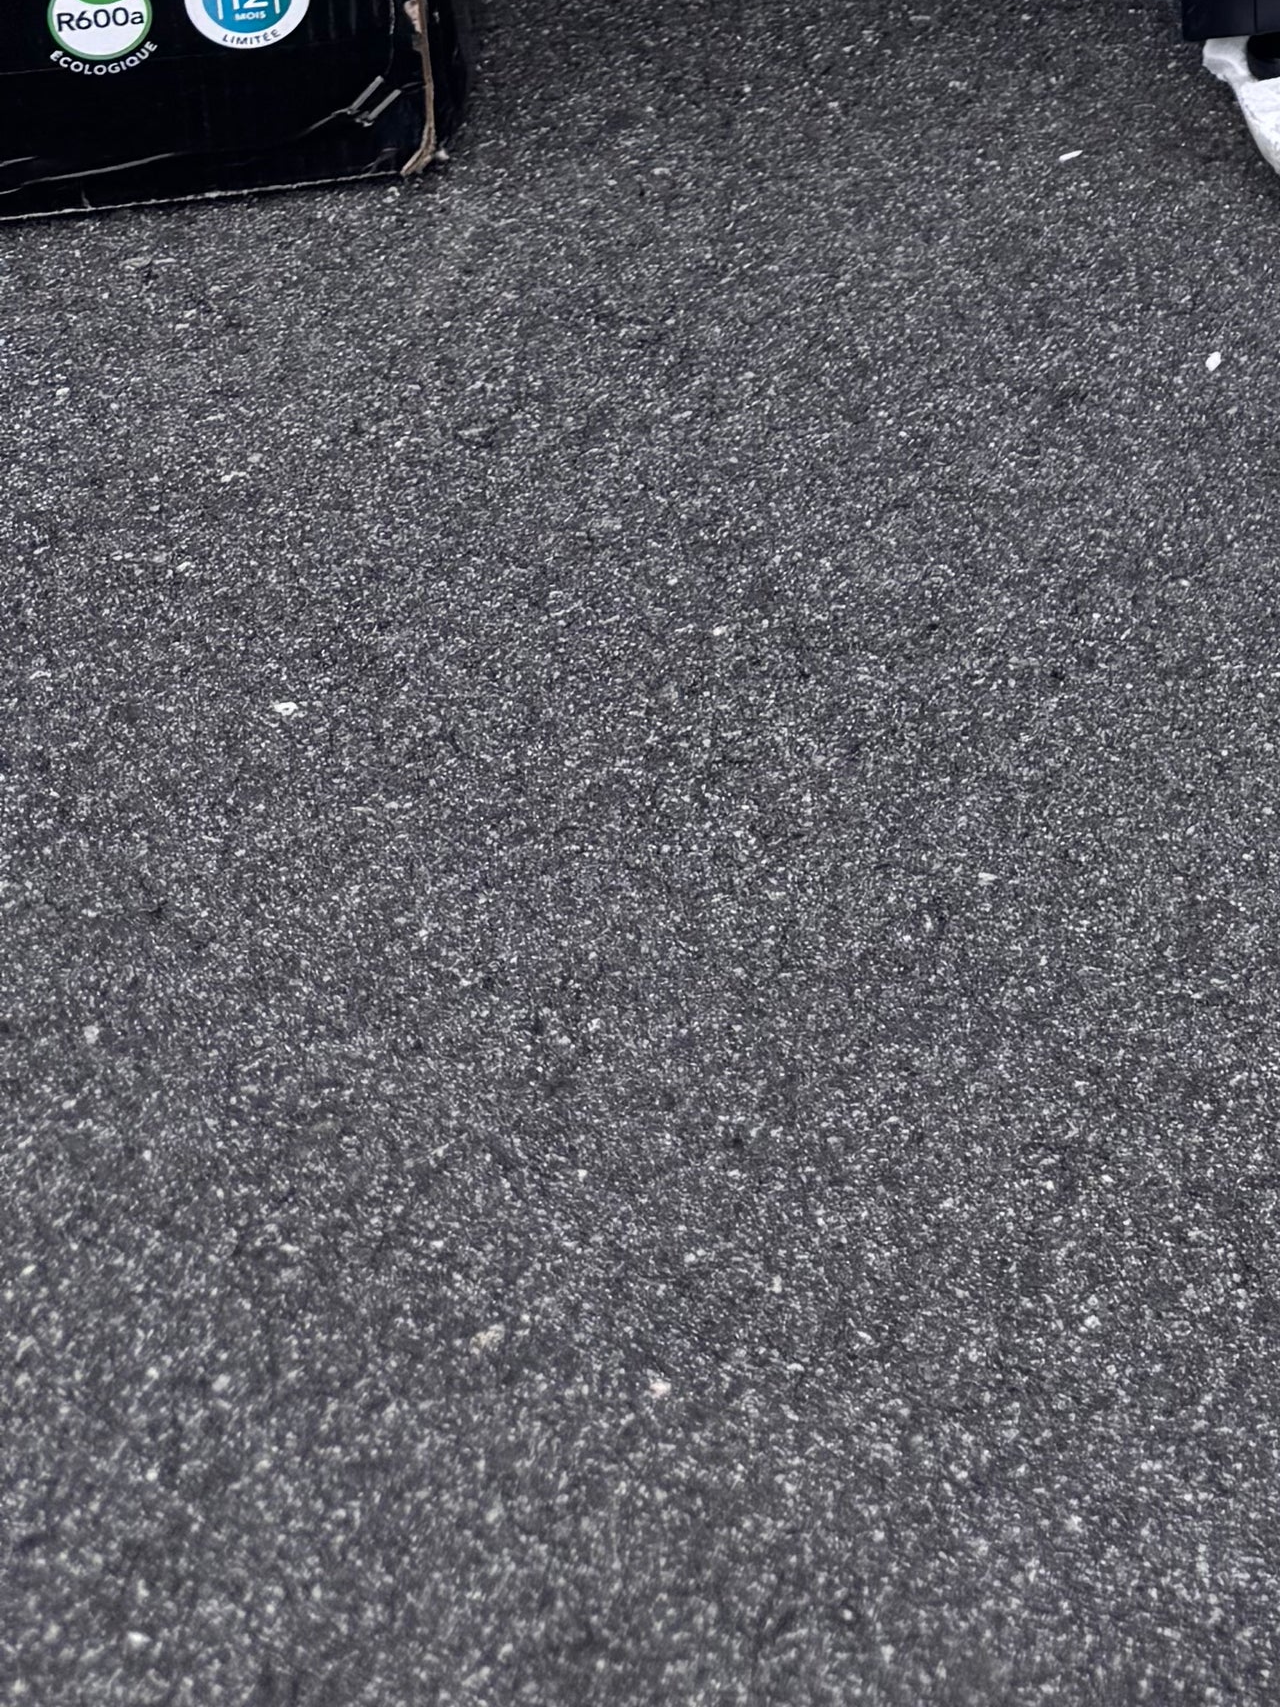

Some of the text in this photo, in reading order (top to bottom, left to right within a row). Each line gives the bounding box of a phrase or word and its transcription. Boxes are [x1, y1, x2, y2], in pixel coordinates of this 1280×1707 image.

[56, 6, 145, 33] R600a
[234, 10, 267, 22] MOIS
[222, 28, 281, 46] LIMITÉE
[49, 40, 158, 76] ÉCOLOGIQUE
